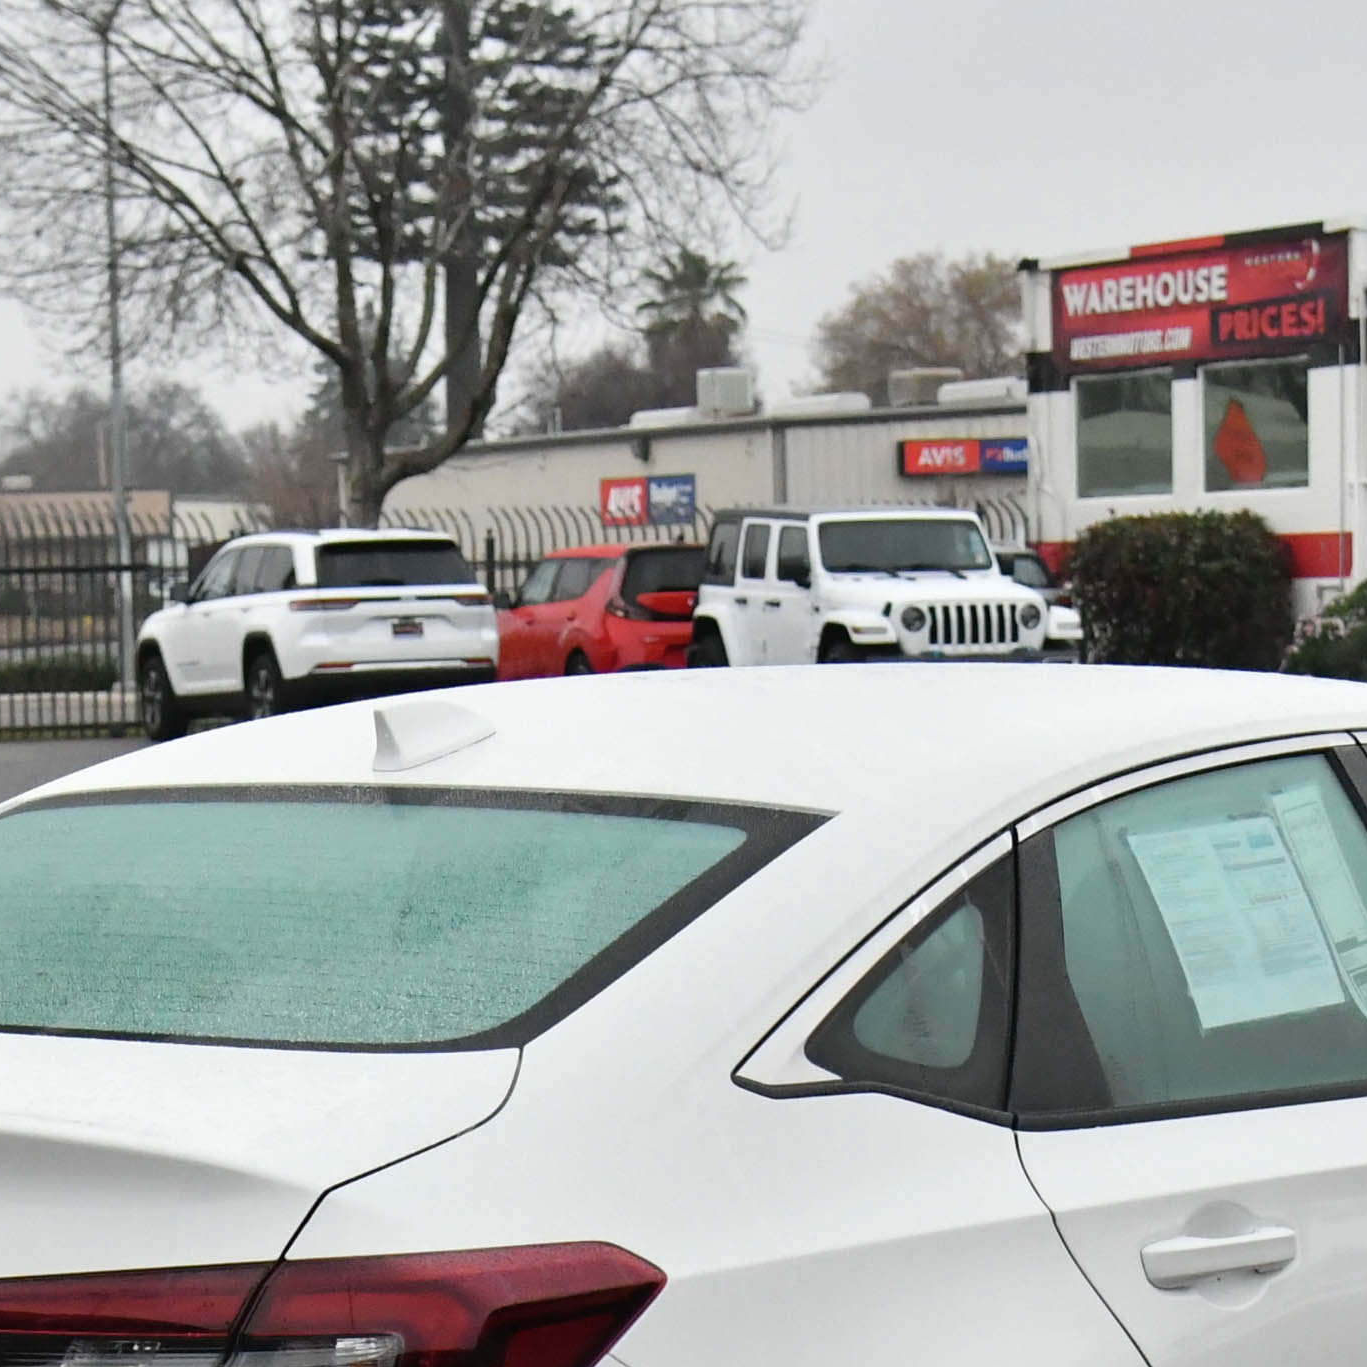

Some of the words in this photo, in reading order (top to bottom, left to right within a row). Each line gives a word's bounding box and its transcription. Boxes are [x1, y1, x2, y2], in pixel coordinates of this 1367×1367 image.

[1062, 264, 1228, 317] WAREHOUSE
[1219, 298, 1325, 342] PRICES!
[917, 445, 966, 466] AVIS
